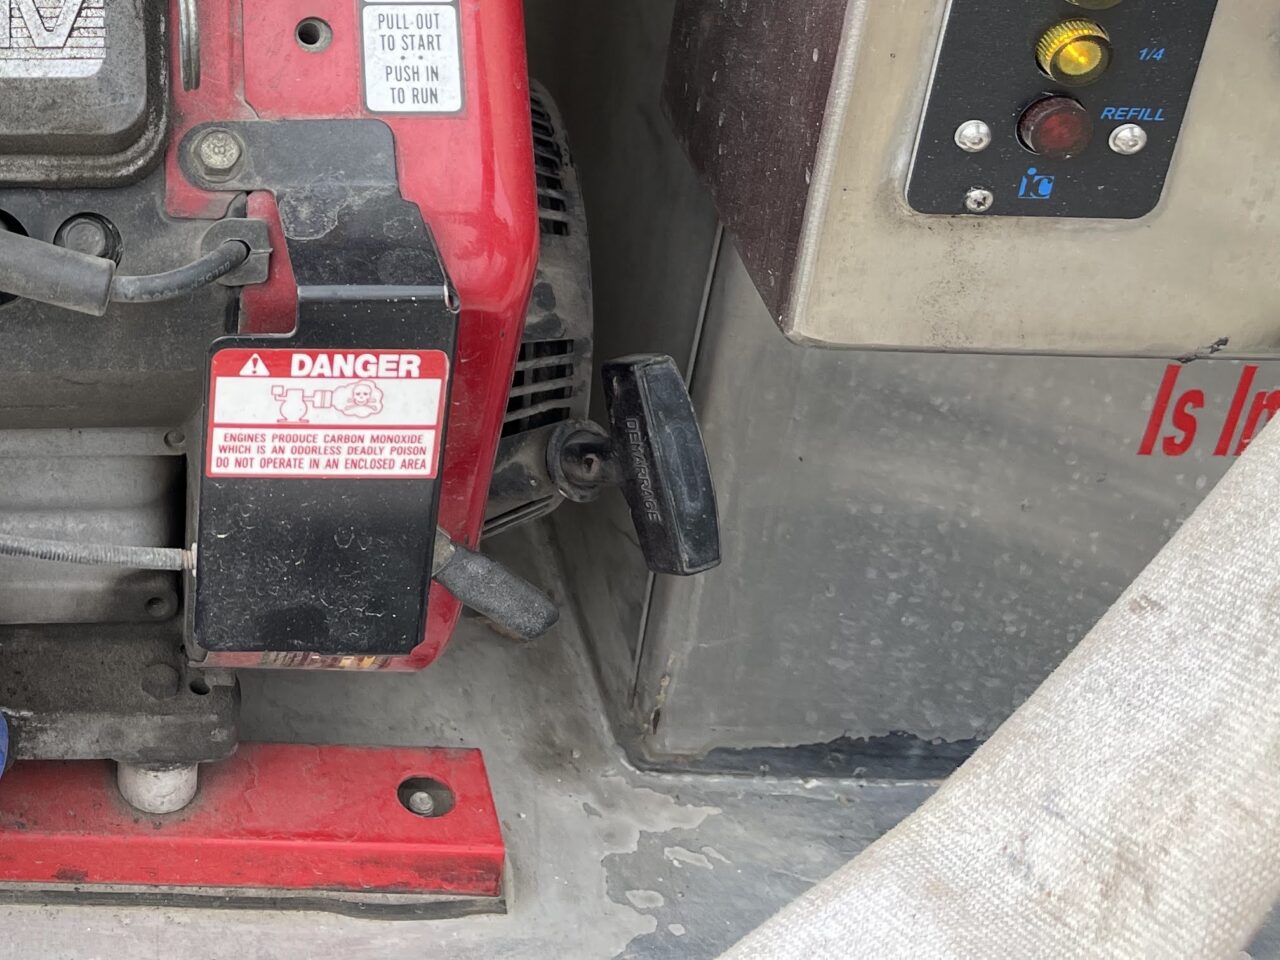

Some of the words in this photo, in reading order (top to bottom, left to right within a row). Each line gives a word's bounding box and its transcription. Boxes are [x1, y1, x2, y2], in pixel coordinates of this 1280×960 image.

[378, 13, 409, 30] PULL
[416, 13, 440, 30] OUT
[380, 34, 395, 51] TO
[401, 34, 442, 51] START
[1138, 47, 1166, 62] 1/4
[385, 65, 420, 82] PUSH
[426, 65, 439, 82] IN
[390, 87, 405, 104] TO
[412, 87, 439, 104] RUN
[1100, 107, 1166, 121] REFILL
[290, 353, 421, 378] DANGER
[1136, 364, 1205, 456] Is
[223, 432, 267, 443] ENGINES
[271, 433, 318, 444] PRODUCE
[323, 433, 365, 444] CARBON
[369, 433, 424, 445] MONOXIDE
[218, 444, 251, 455] WHICH
[256, 445, 266, 455] IS
[270, 445, 286, 456] AN
[290, 445, 342, 456] ODORLESS
[347, 445, 385, 456] DEADLY
[390, 445, 427, 456] POISON
[216, 457, 230, 469] DO
[235, 457, 254, 469] NOT
[259, 458, 305, 469] OPERATE
[309, 458, 319, 469] IN
[324, 458, 339, 470] AN
[344, 458, 395, 470] ENCLOSED
[400, 458, 427, 470] AREA
